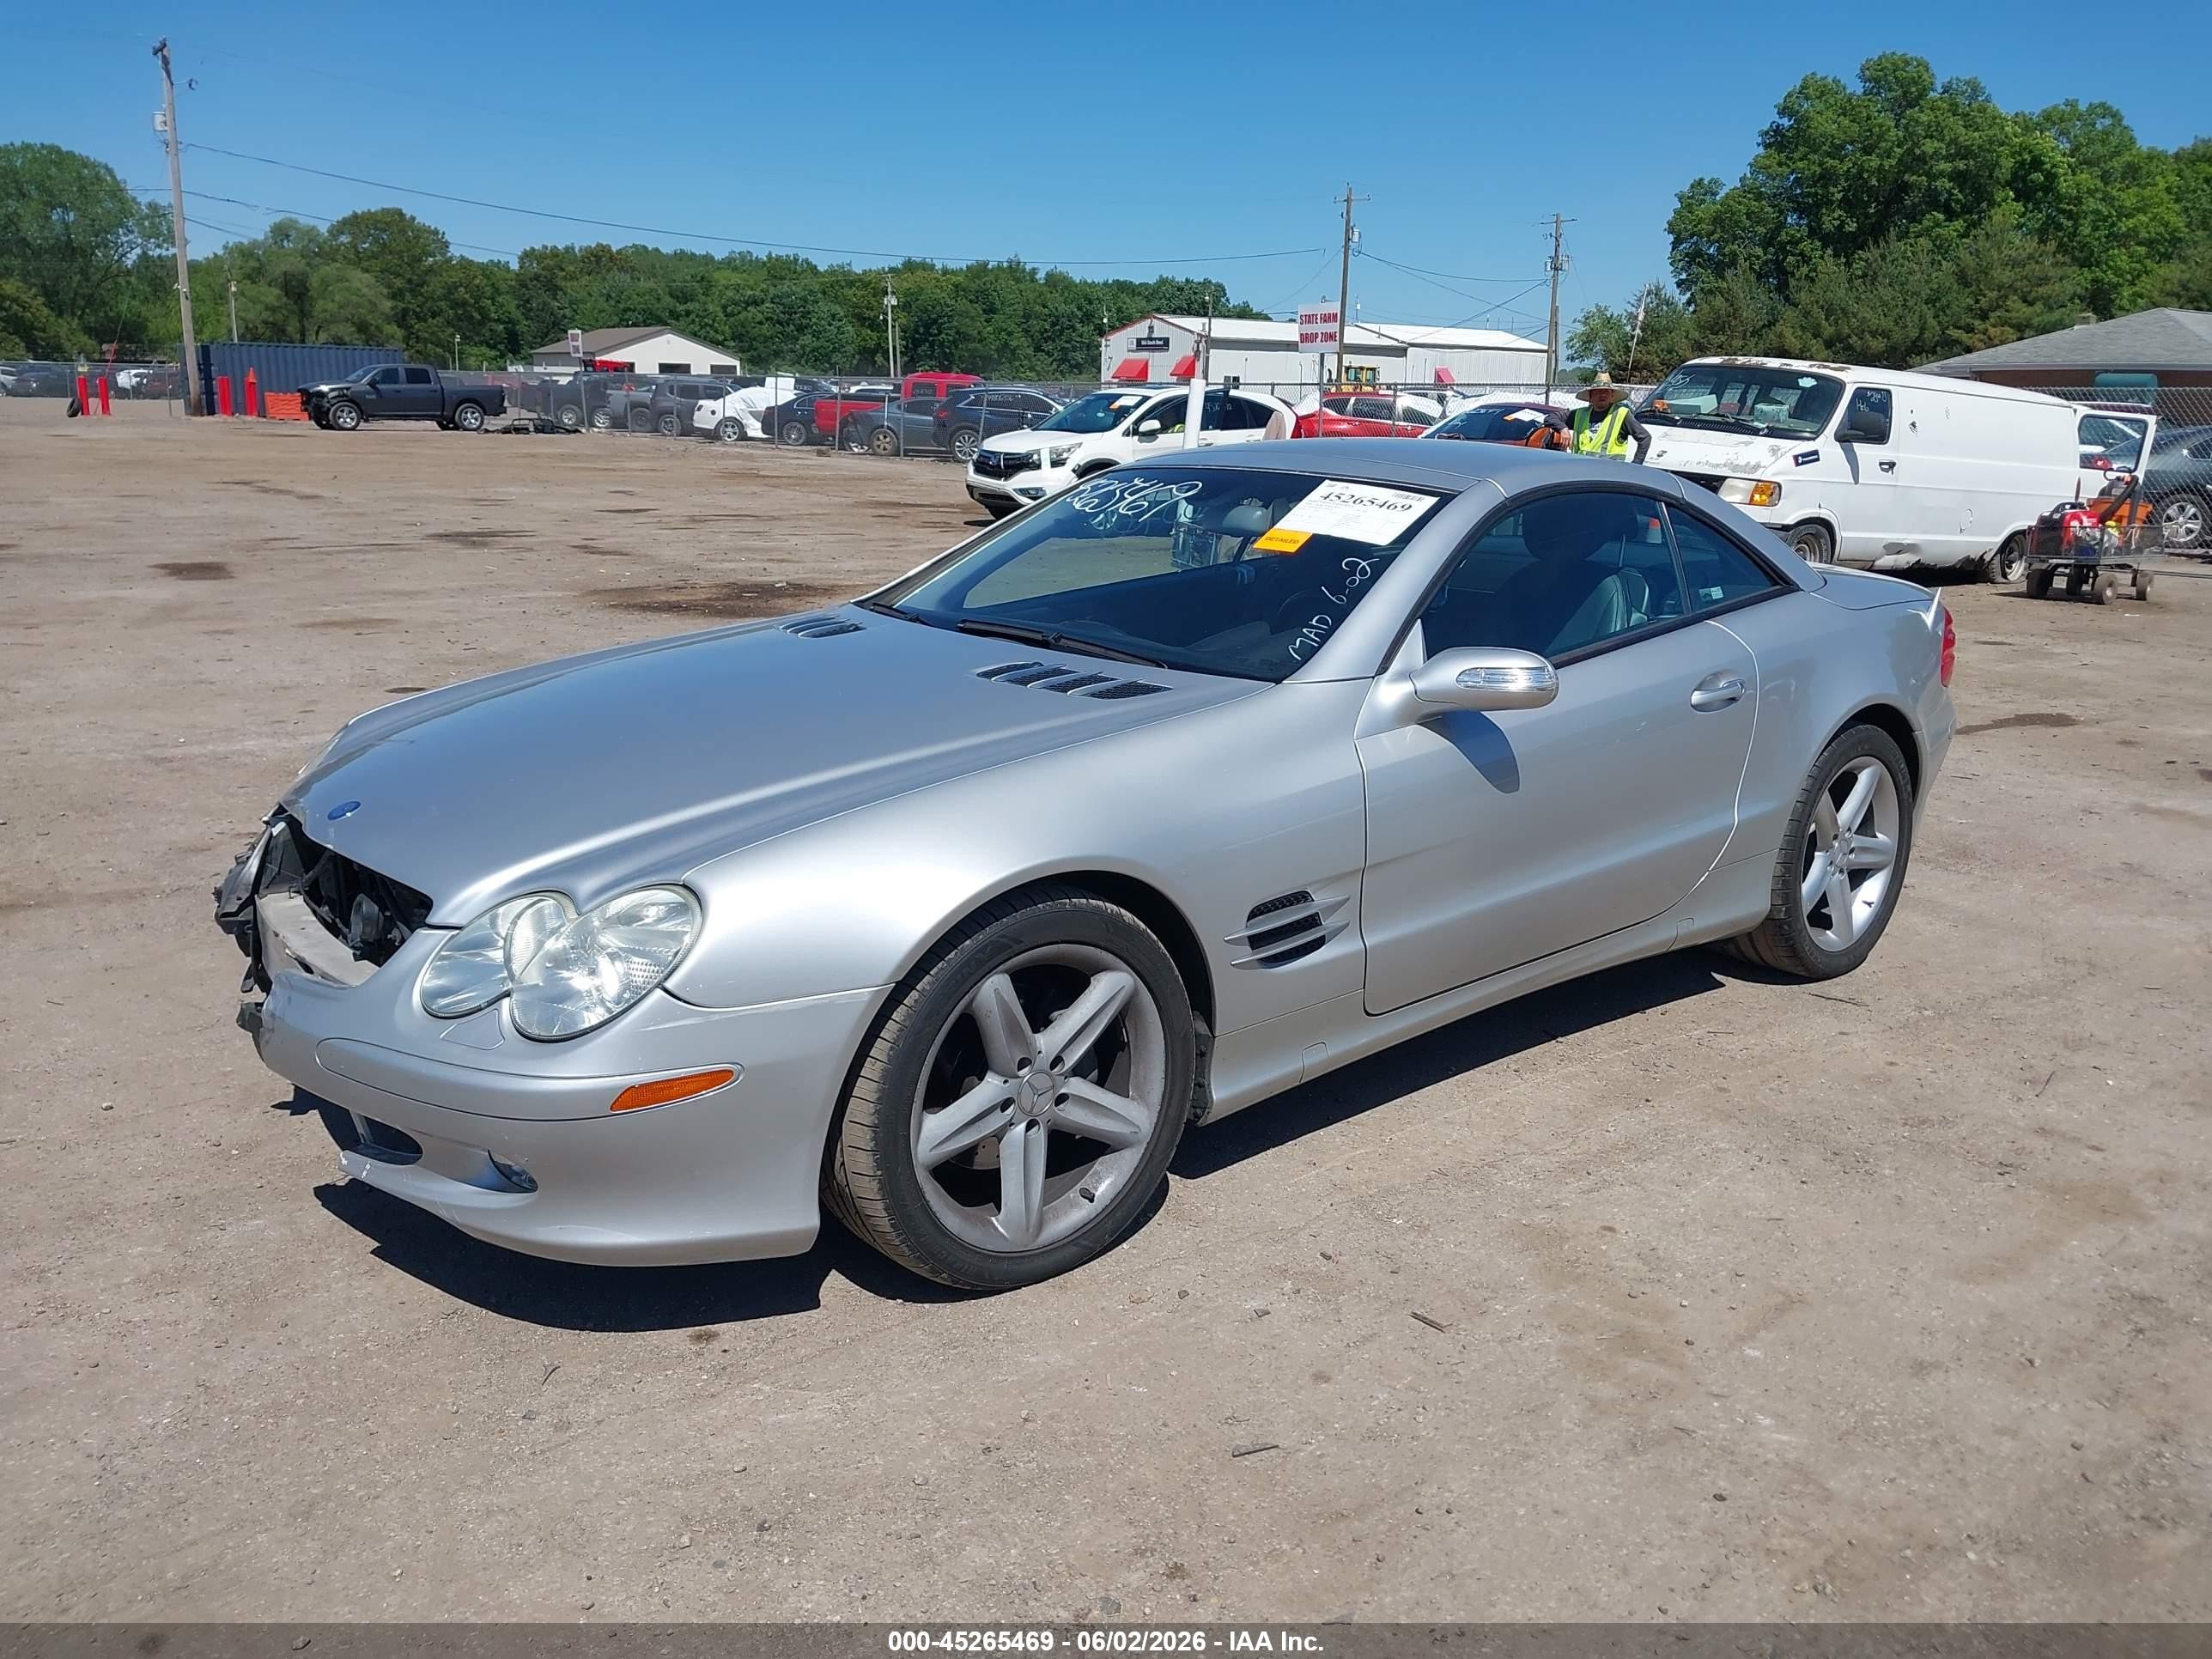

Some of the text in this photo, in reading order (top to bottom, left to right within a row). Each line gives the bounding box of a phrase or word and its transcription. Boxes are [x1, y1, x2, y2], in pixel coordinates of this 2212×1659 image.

[1299, 312, 1338, 325] STATE FARM
[1300, 331, 1338, 343] DROP ZONE
[1320, 491, 1413, 513] 45265469
[1264, 536, 1300, 544] DETAILED
[1288, 614, 1332, 660] MAD
